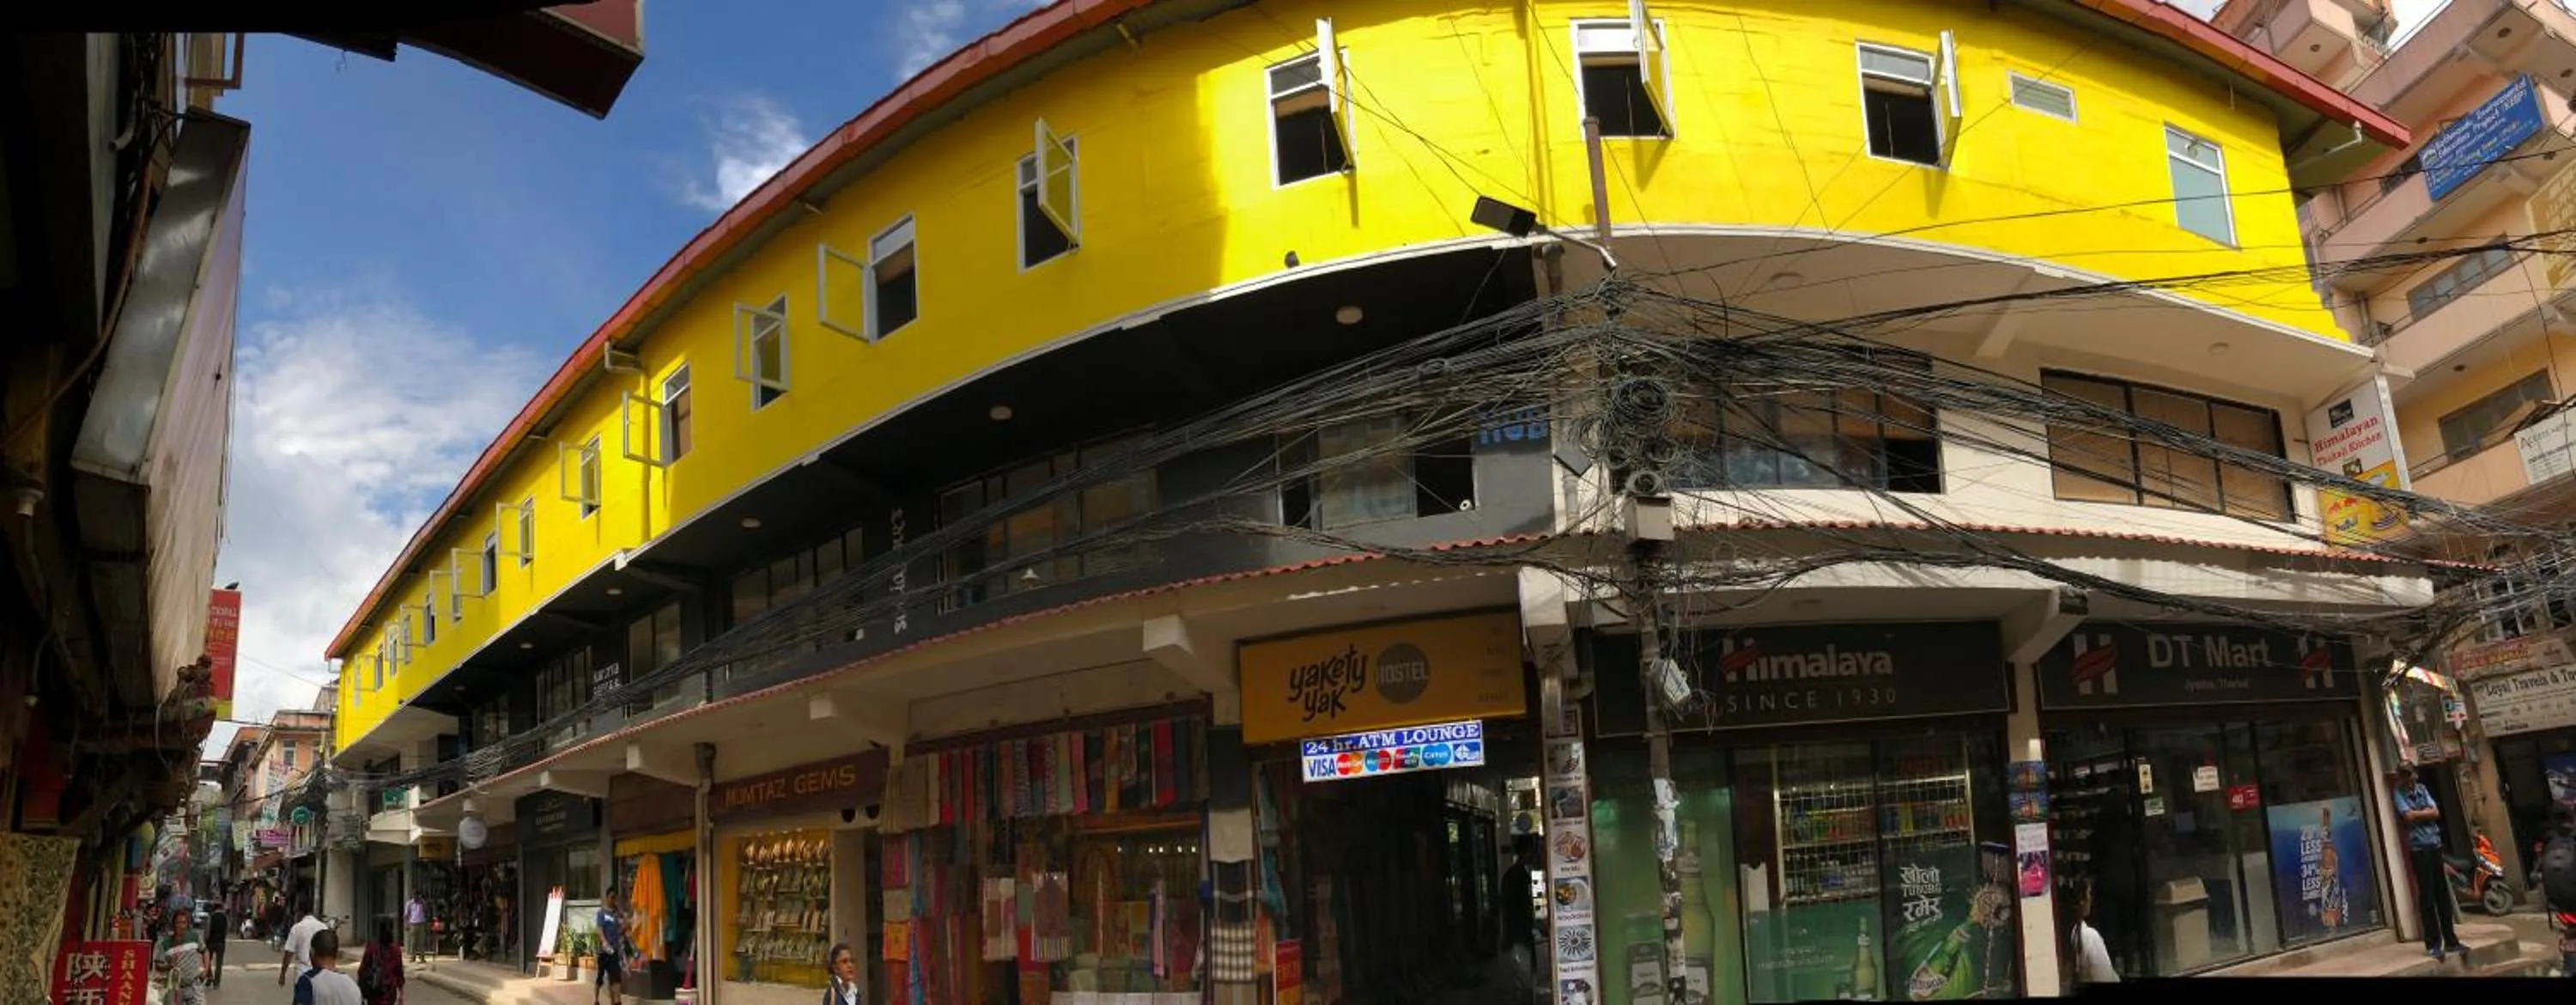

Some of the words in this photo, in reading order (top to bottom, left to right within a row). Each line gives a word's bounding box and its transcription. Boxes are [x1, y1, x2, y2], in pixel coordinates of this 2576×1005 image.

[2314, 417, 2379, 450] Himalayan
[2148, 633, 2194, 667] DT
[2204, 636, 2269, 668] Mart
[1288, 643, 1369, 702] yakety
[2512, 675, 2549, 691] Travels
[1303, 686, 1346, 722] yak
[1725, 695, 1819, 713] SINCE
[1836, 686, 1897, 708] 1930
[1306, 741, 1329, 755] 24
[1358, 733, 1397, 749] ATM
[1402, 724, 1479, 745] LOUNGE
[793, 764, 856, 795] GEMS
[1308, 759, 1337, 778] VISA
